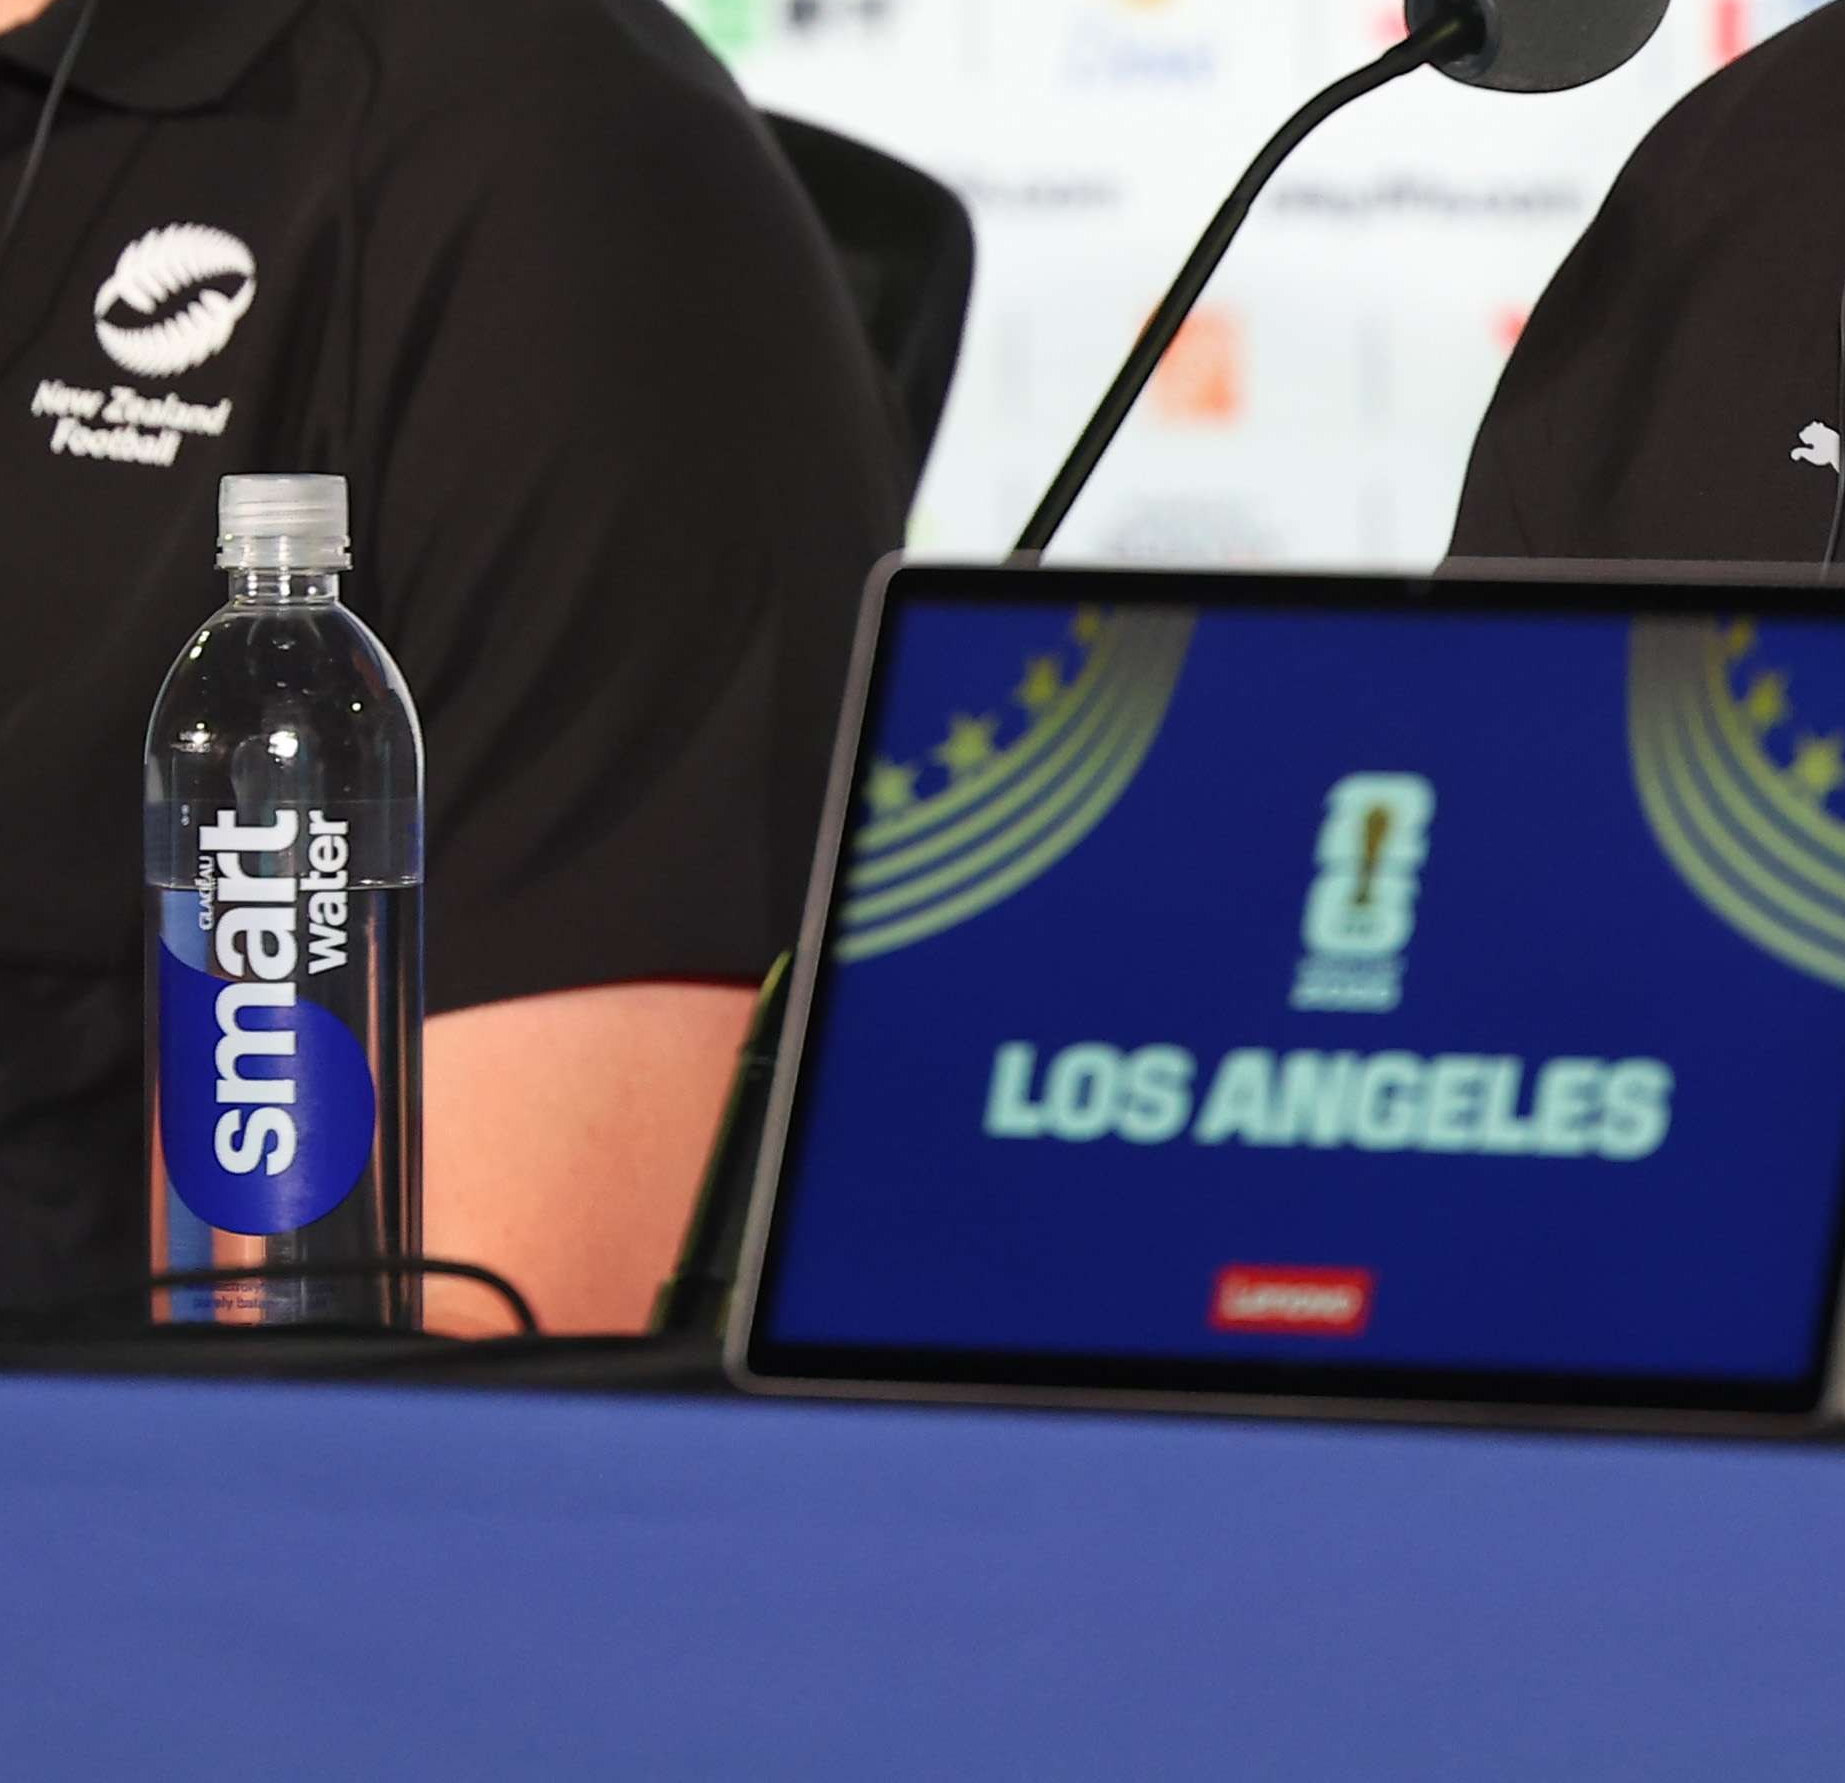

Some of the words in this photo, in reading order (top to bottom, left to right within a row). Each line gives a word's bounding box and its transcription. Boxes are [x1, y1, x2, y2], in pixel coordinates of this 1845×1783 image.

[31, 379, 106, 420] New
[102, 385, 233, 437] Zealand
[50, 416, 183, 467] Football
[298, 808, 350, 976] water
[198, 808, 299, 1178] smart
[986, 1043, 1196, 1142] LOS
[1190, 1049, 1672, 1159] ANGELES
